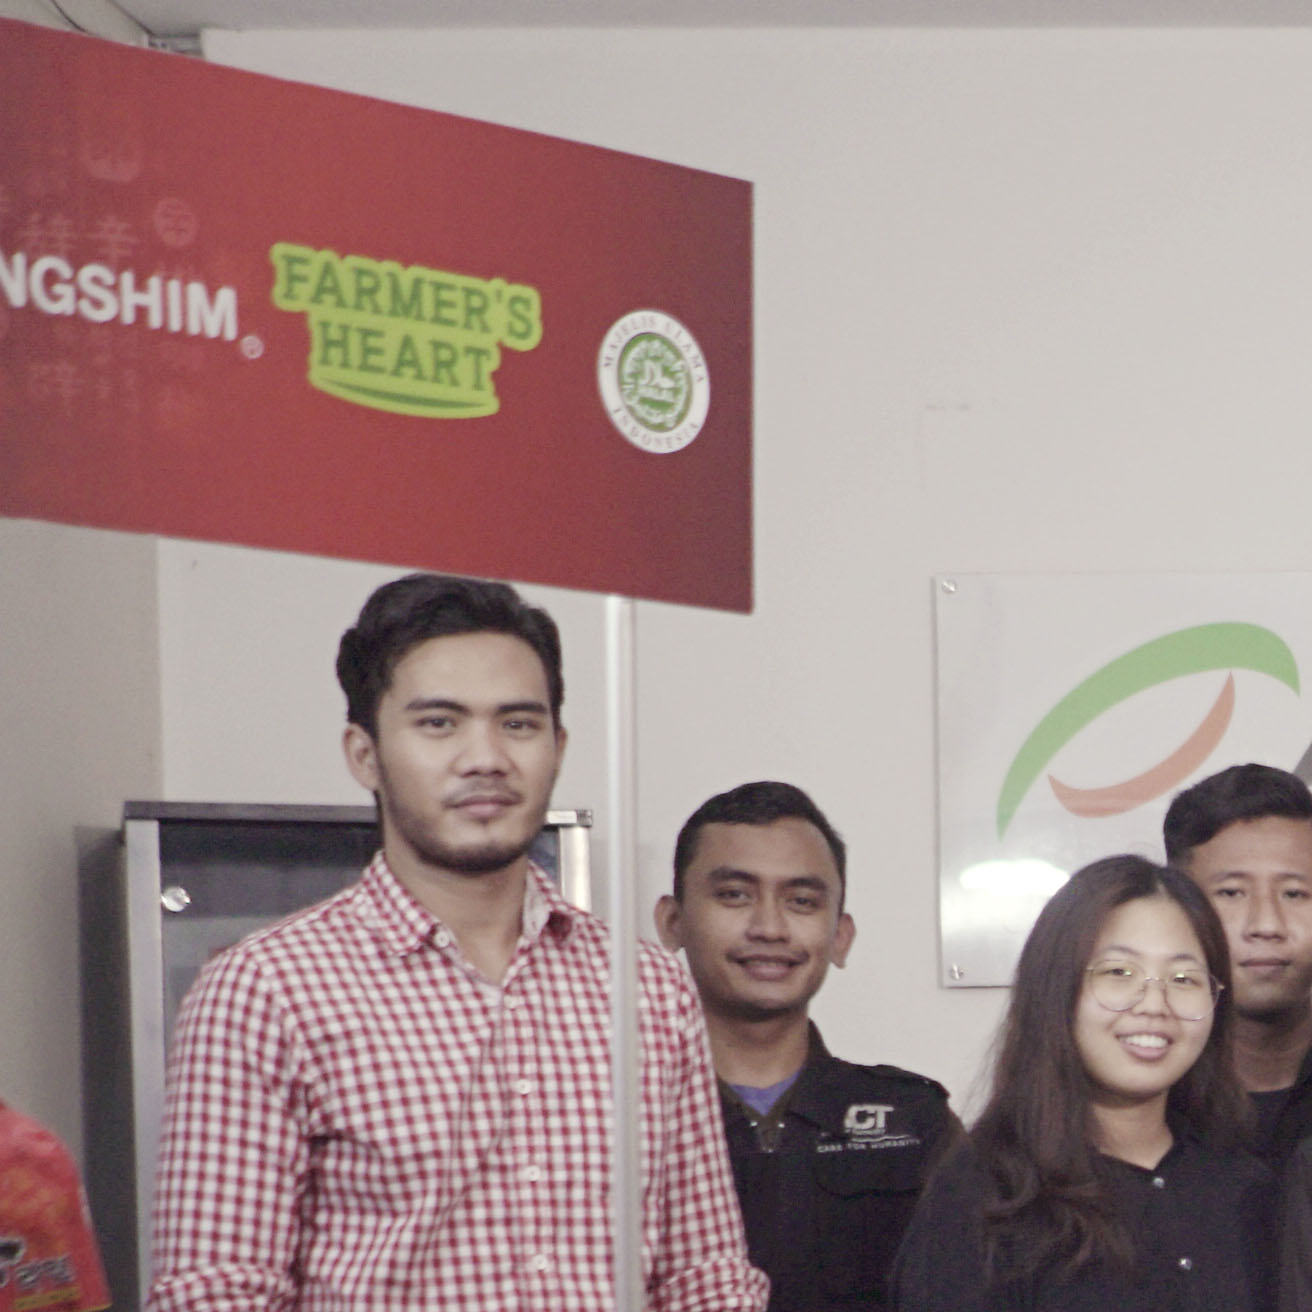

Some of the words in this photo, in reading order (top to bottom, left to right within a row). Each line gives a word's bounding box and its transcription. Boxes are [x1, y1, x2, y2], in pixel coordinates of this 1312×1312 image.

[277, 252, 536, 342] FARMER'S
[316, 318, 494, 393] HEART
[842, 1103, 896, 1131] CT
